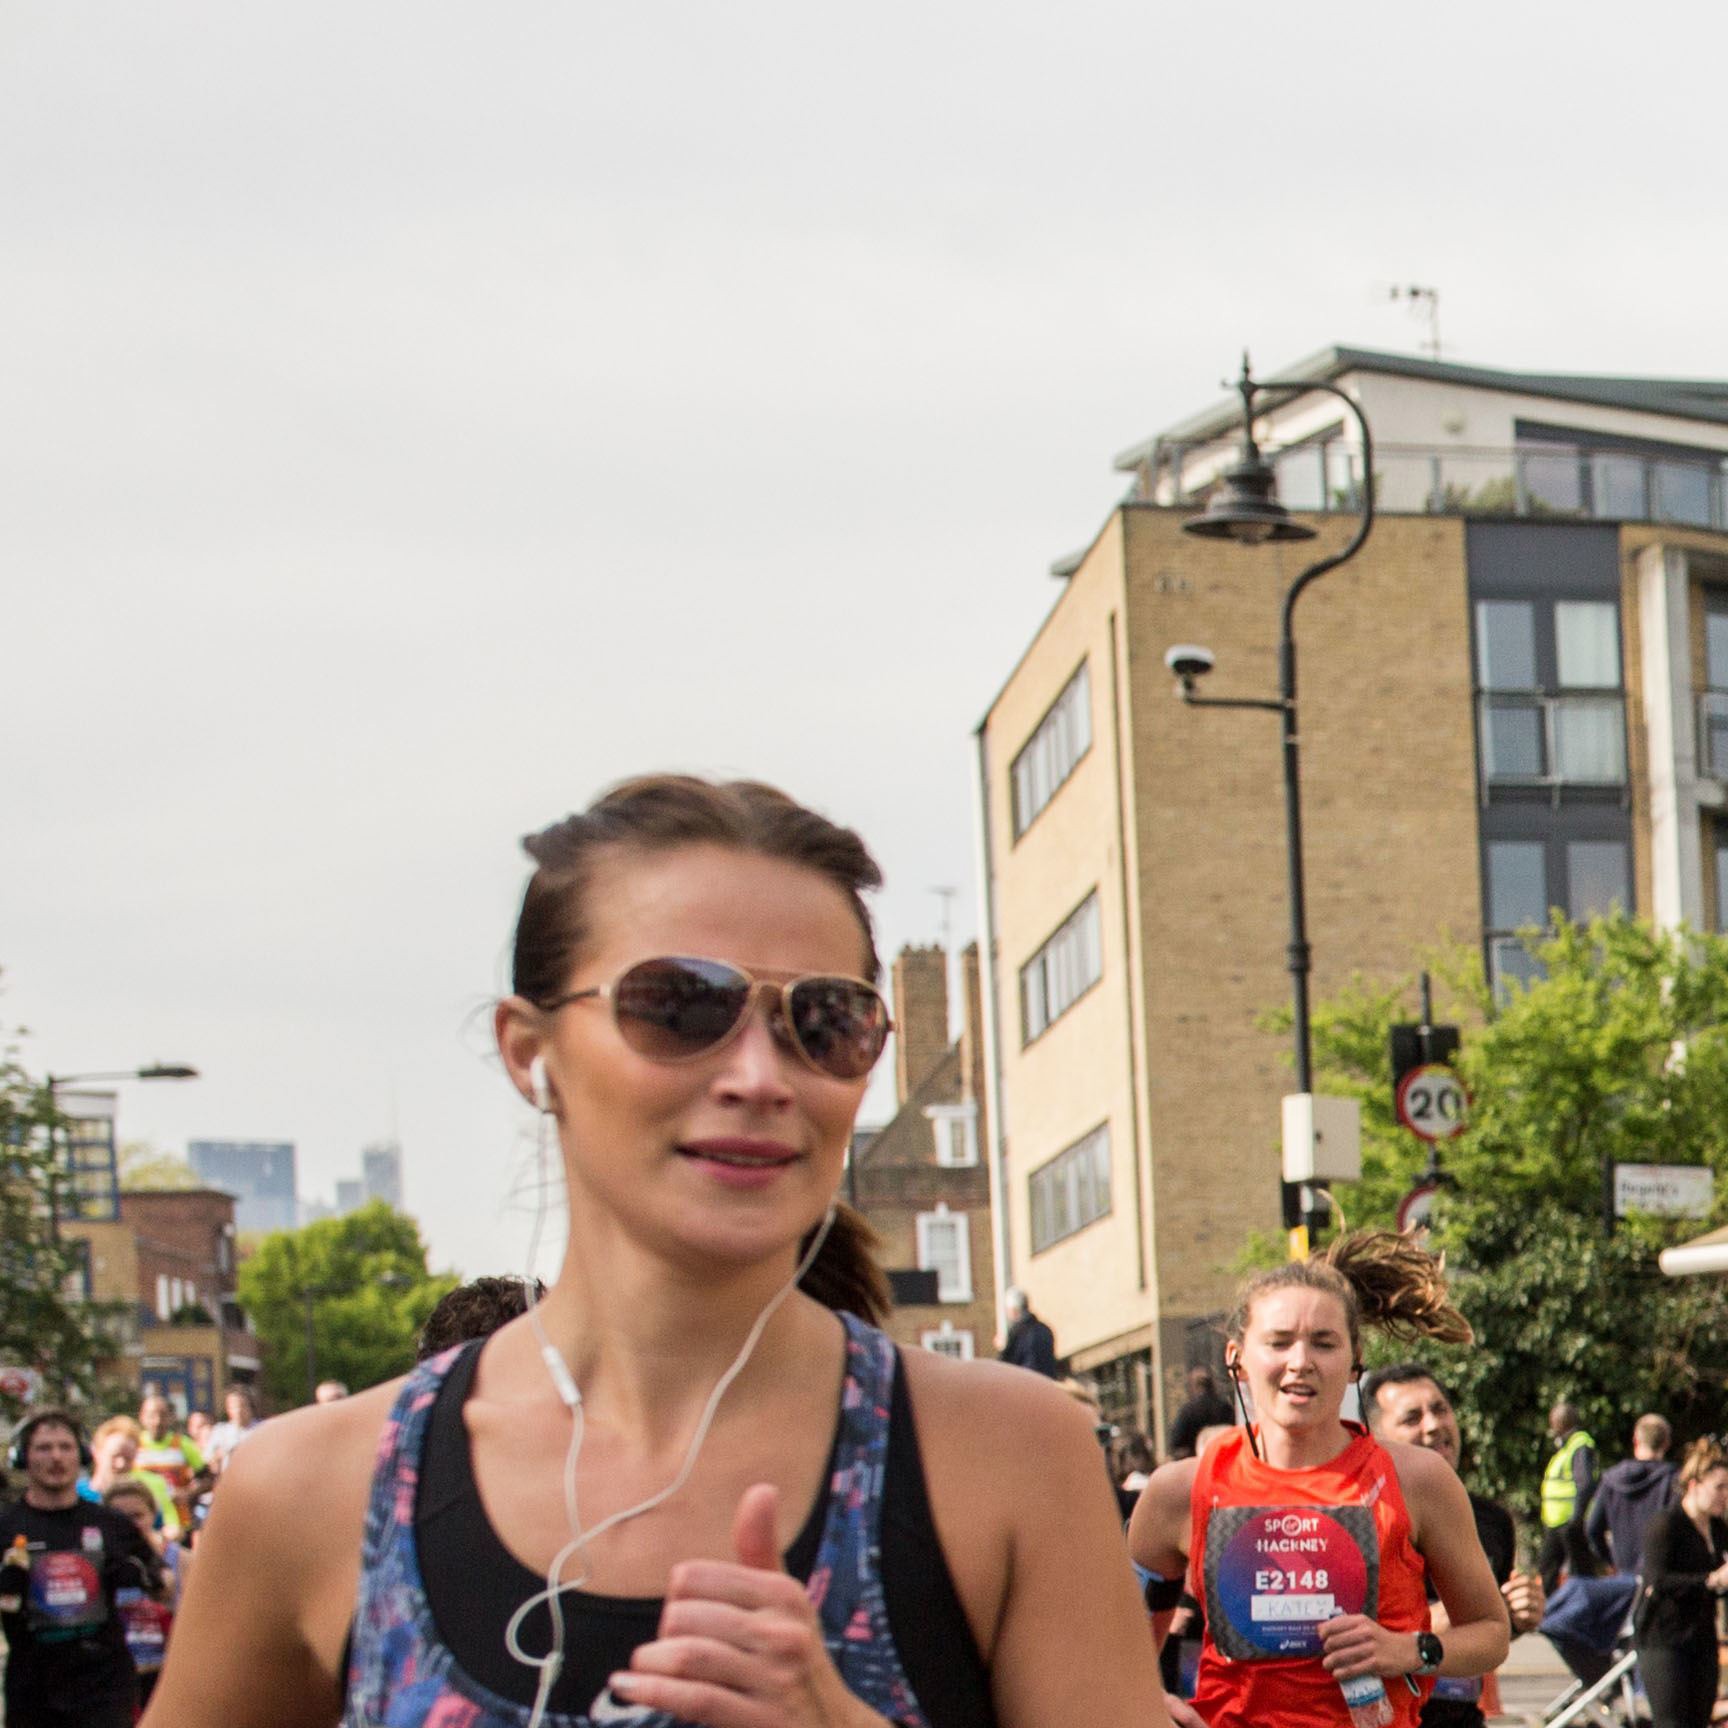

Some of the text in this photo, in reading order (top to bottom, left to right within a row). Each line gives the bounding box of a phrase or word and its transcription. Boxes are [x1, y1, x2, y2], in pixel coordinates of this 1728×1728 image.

[1410, 1086, 1462, 1121] 20
[1264, 1514, 1320, 1537] SPORT
[1255, 1538, 1329, 1553] HACKNEY
[1255, 1569, 1329, 1591] E2148
